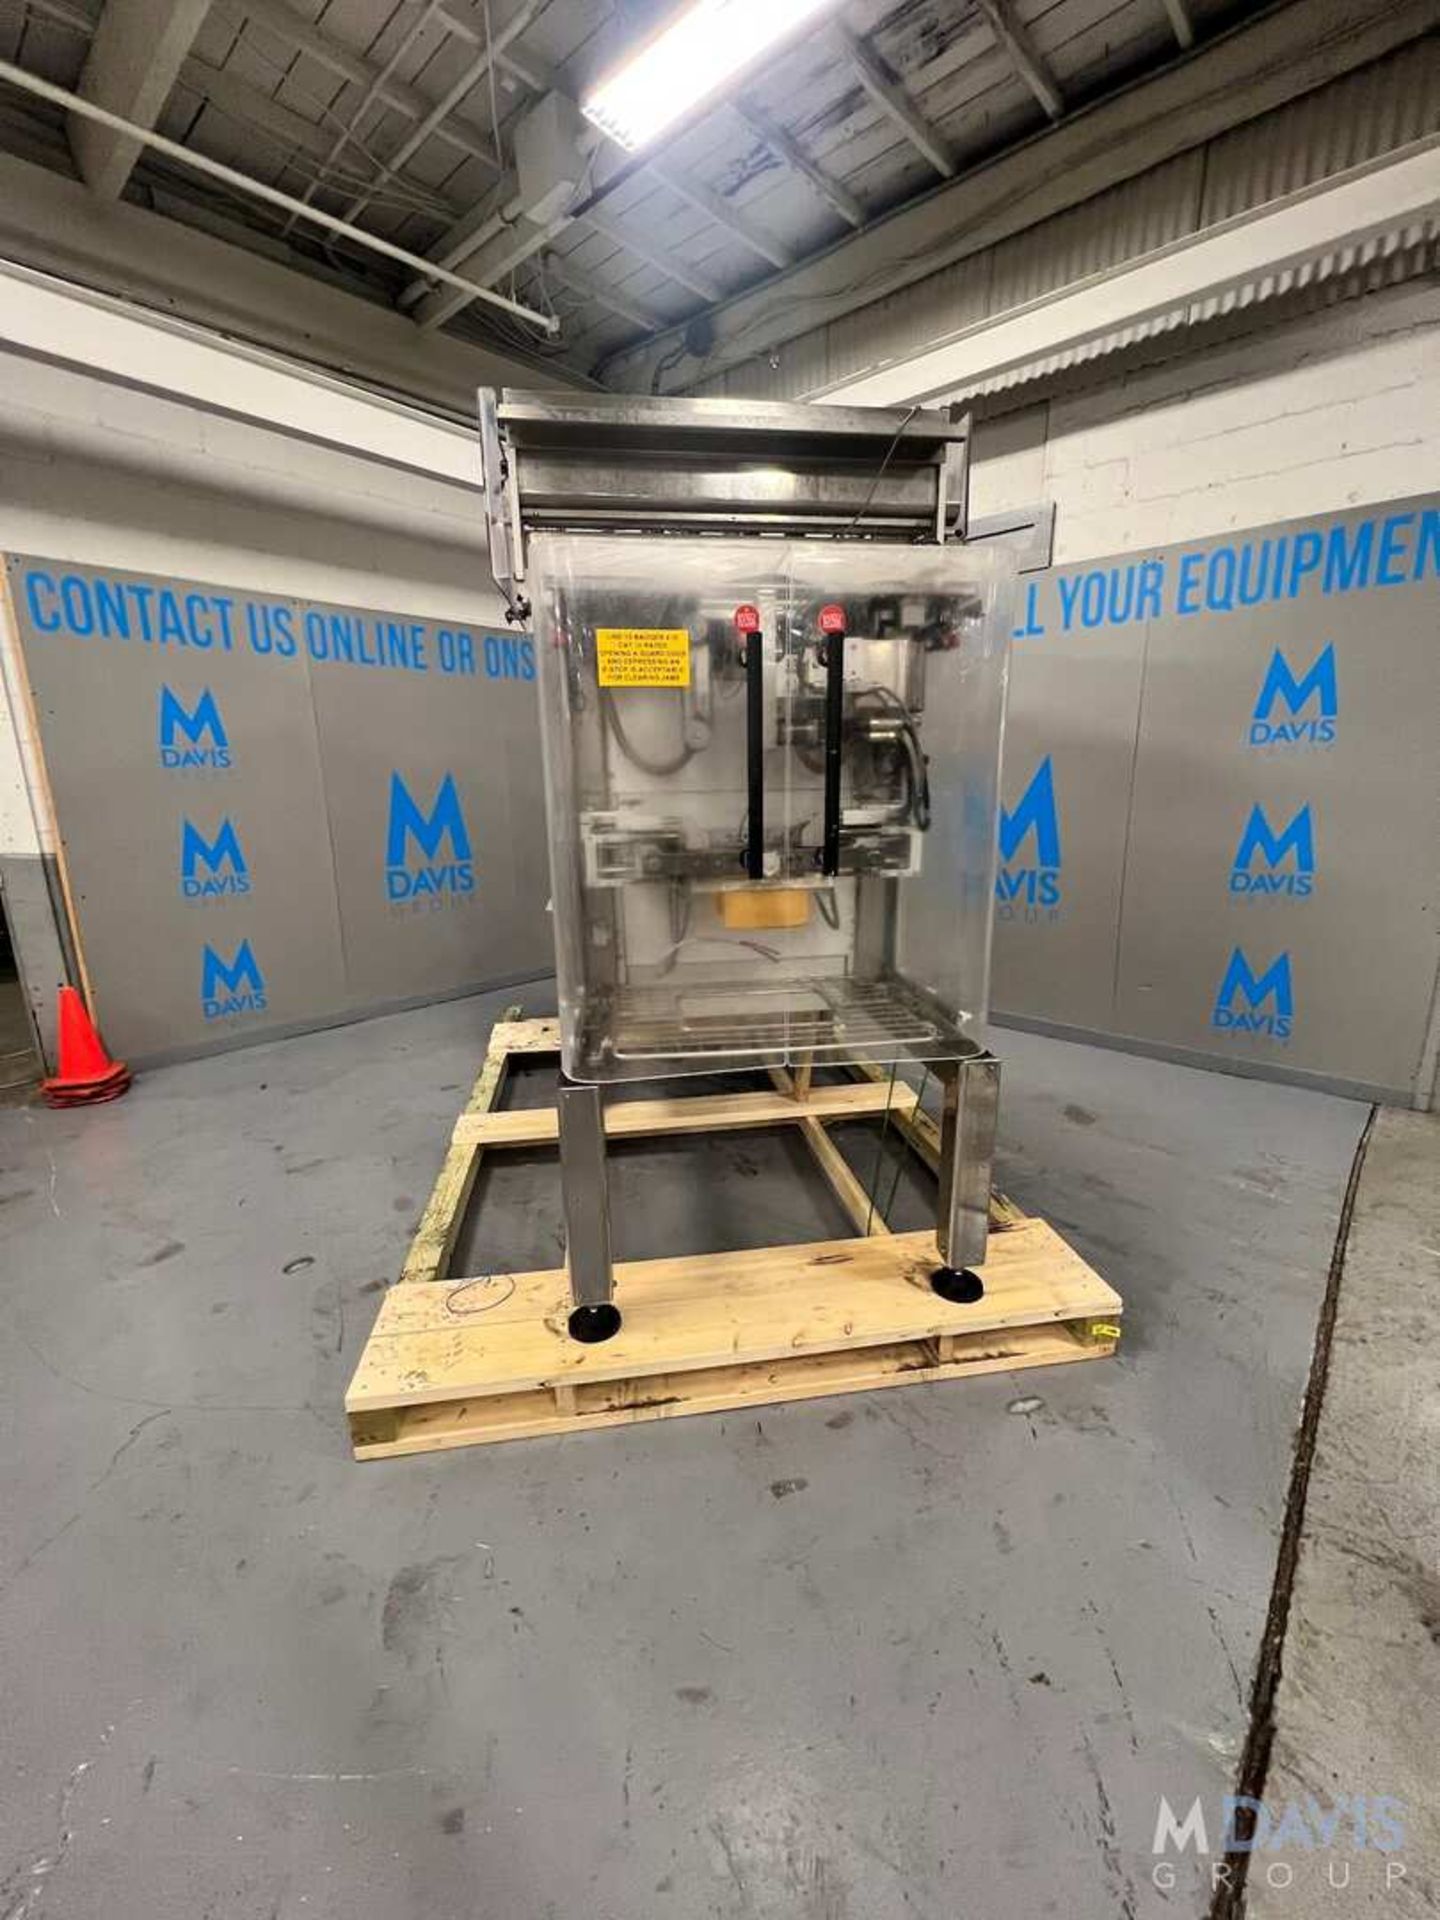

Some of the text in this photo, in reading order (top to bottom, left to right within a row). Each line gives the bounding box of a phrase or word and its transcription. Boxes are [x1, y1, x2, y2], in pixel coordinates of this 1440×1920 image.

[26, 571, 536, 681] CONTACT US ONLINE OR ONS
[1058, 558, 1166, 635] YOUR
[1253, 640, 1338, 719] M
[160, 684, 228, 747] M
[1250, 718, 1338, 746] DAVIS
[162, 746, 231, 769] DAVIS
[182, 817, 248, 877] M
[387, 769, 473, 867] M
[1233, 803, 1316, 872] M
[183, 875, 250, 897] DAVIS
[387, 863, 475, 901] DAVIS
[996, 870, 1061, 907] AVIS
[1229, 870, 1313, 897] DAVIS
[202, 938, 265, 999] M
[1221, 945, 1294, 1015] M
[203, 992, 268, 1019] DAVIS
[1214, 1008, 1293, 1039] DAVIS
